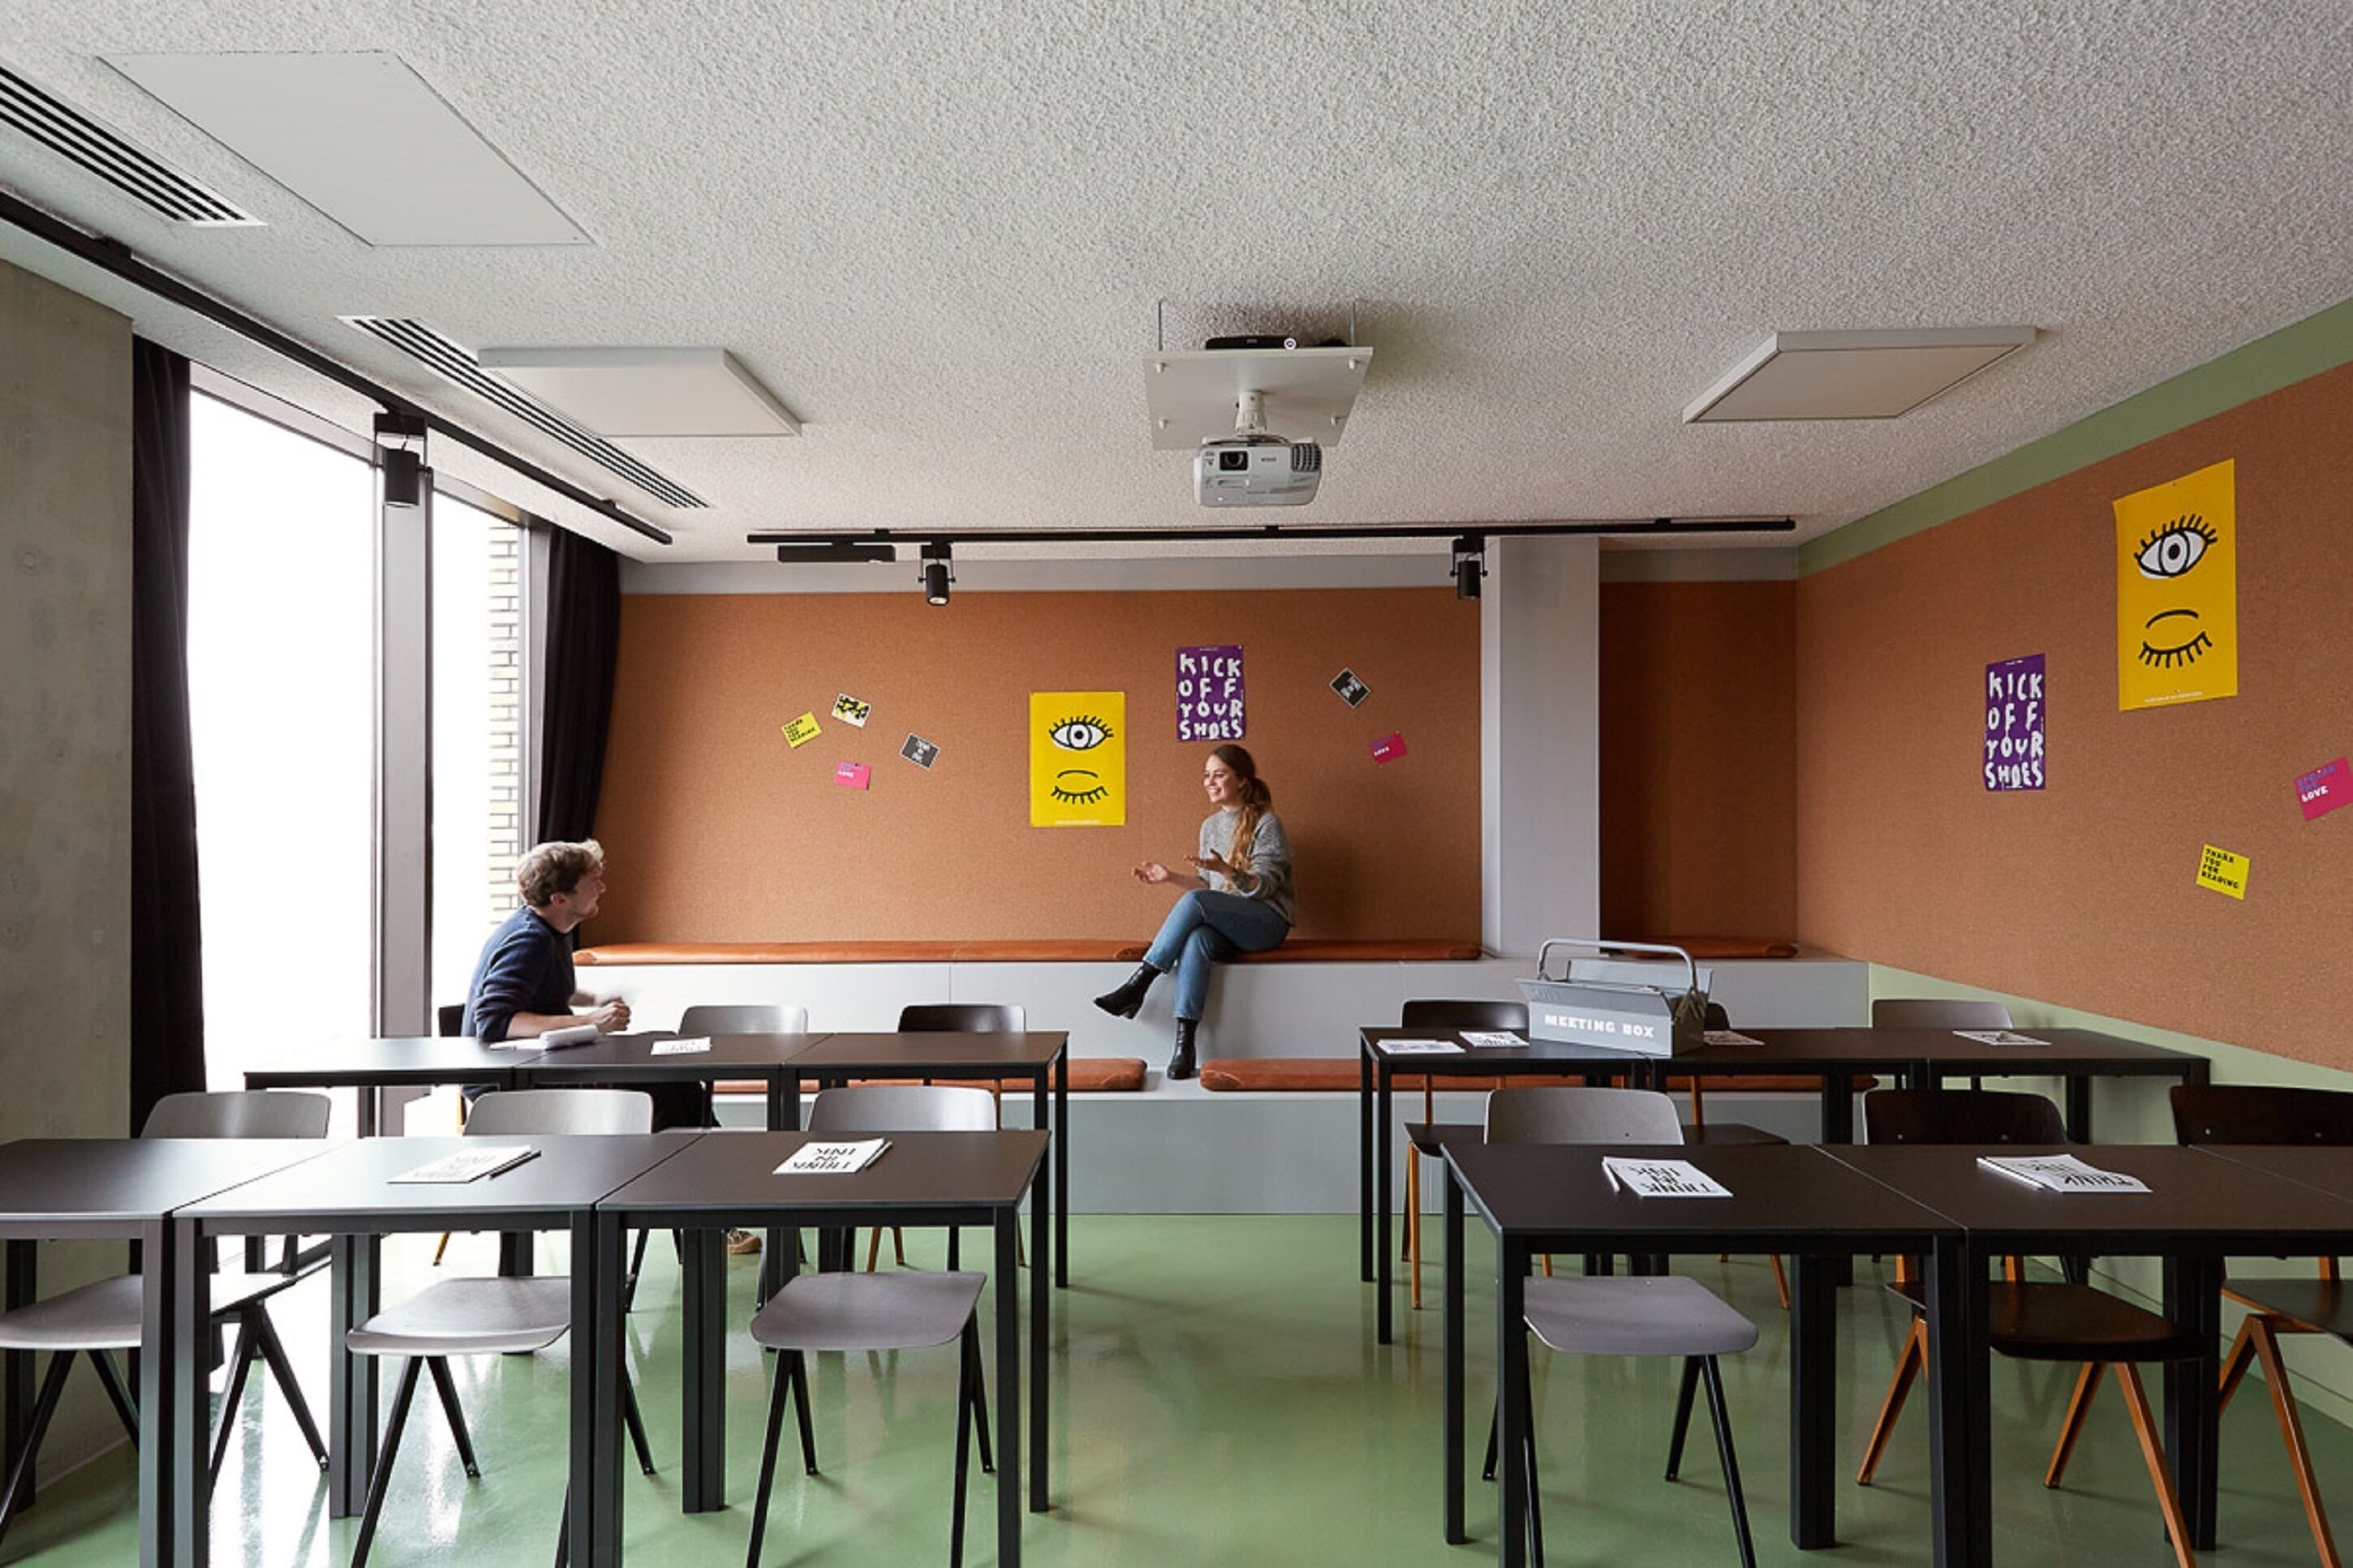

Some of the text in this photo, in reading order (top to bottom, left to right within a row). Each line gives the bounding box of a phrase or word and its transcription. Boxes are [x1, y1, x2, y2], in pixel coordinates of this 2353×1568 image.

[1179, 653, 1241, 677] KICK
[1177, 677, 1237, 698] OFF
[1989, 671, 2043, 701] KICK
[1179, 699, 1244, 719] YOUR
[1988, 701, 2038, 731] OFF
[1179, 719, 1244, 740] SHOES
[1986, 730, 2044, 760] YOUR
[1985, 761, 2044, 789] SHOES
[2301, 785, 2329, 802] LOVE
[1544, 1014, 1654, 1038] MEETING BOX
